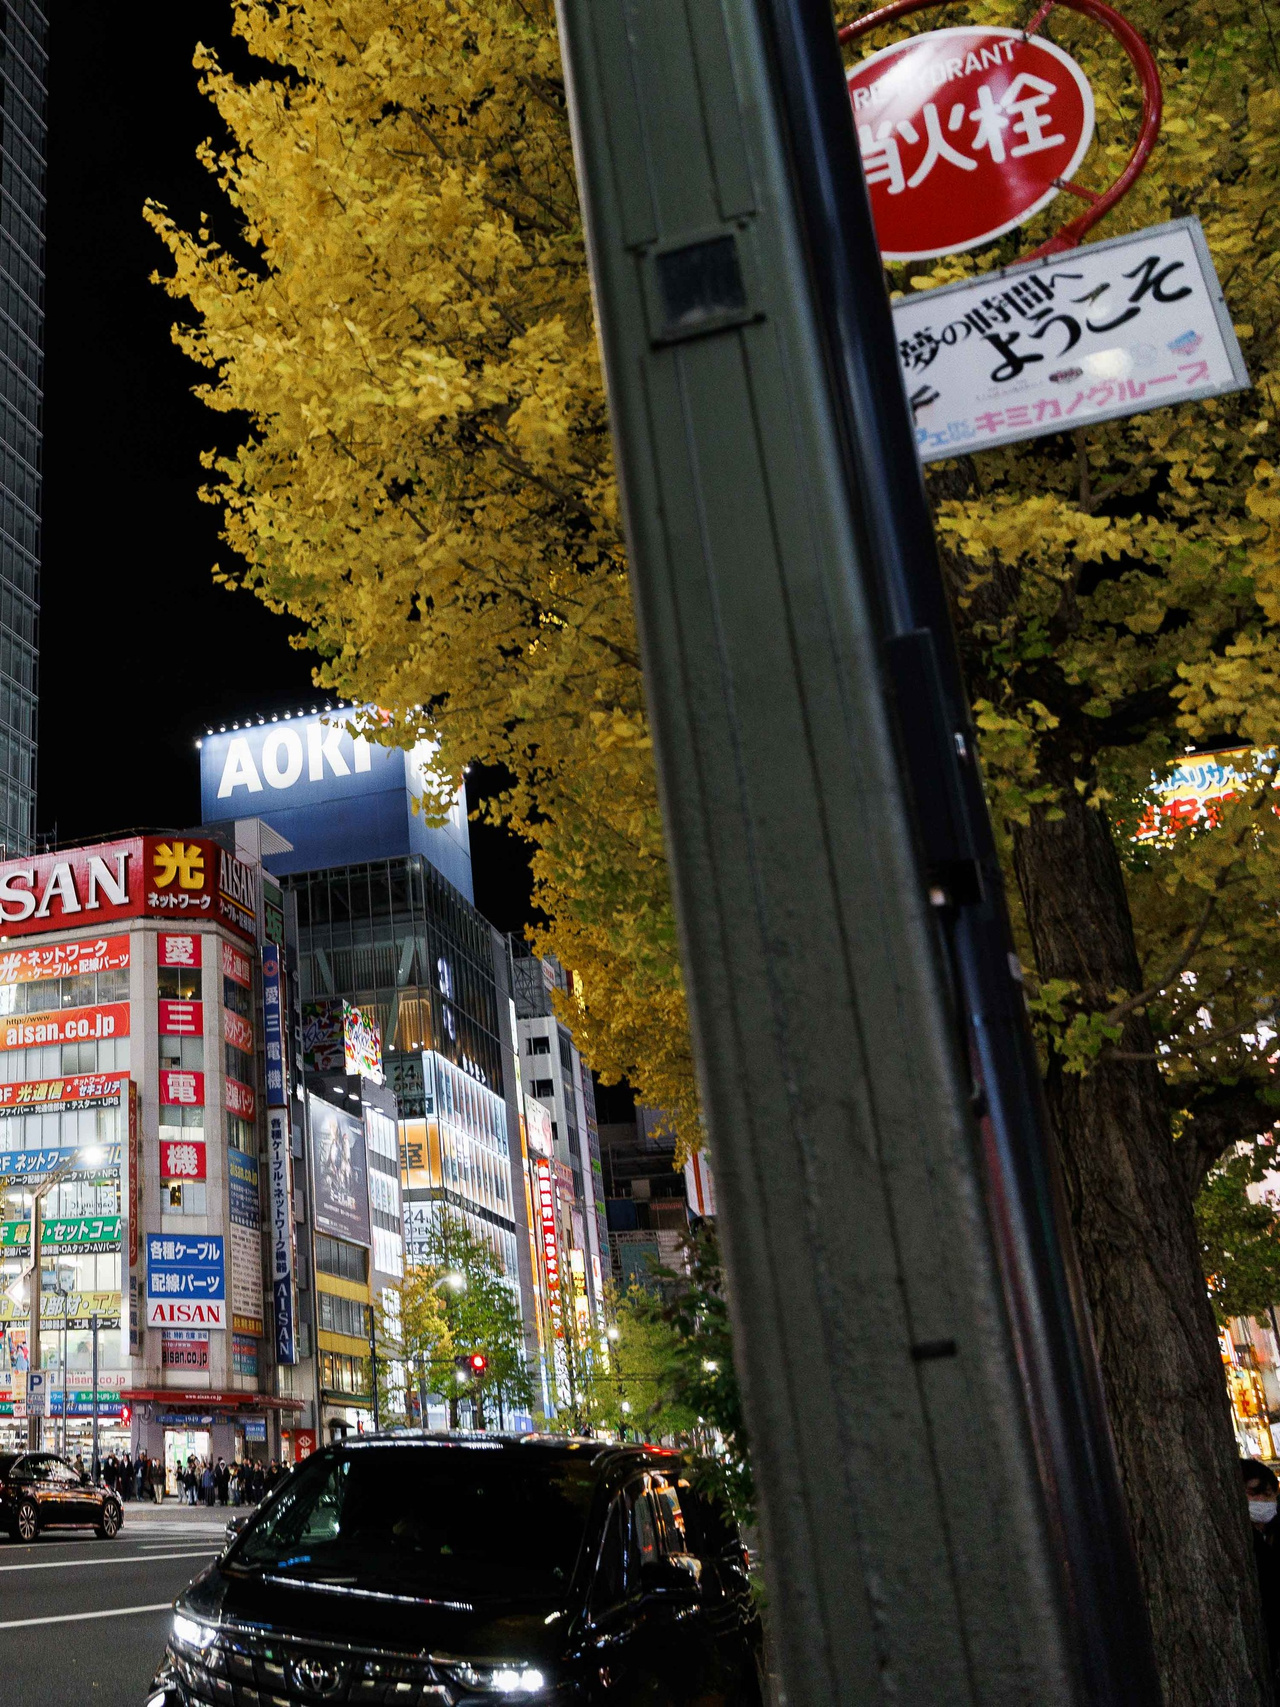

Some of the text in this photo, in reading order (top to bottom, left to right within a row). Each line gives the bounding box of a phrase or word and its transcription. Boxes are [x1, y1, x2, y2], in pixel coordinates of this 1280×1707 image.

[901, 274, 1084, 374] 夢の時間へ
[980, 256, 1193, 383] ようこそ
[217, 722, 372, 799] AOKI
[153, 841, 205, 890] 光
[220, 848, 255, 914] AISAN
[147, 892, 212, 910] ネットワーク
[6, 1014, 116, 1046] aisan.co.jp
[265, 986, 282, 1090] 愛三電機
[150, 1240, 220, 1260] 各種ケーブル
[151, 1273, 220, 1293] 配線パーツ
[151, 1304, 222, 1323] AISAN
[277, 1282, 291, 1357] AISAN
[162, 1349, 208, 1367] aisan.co.jp
